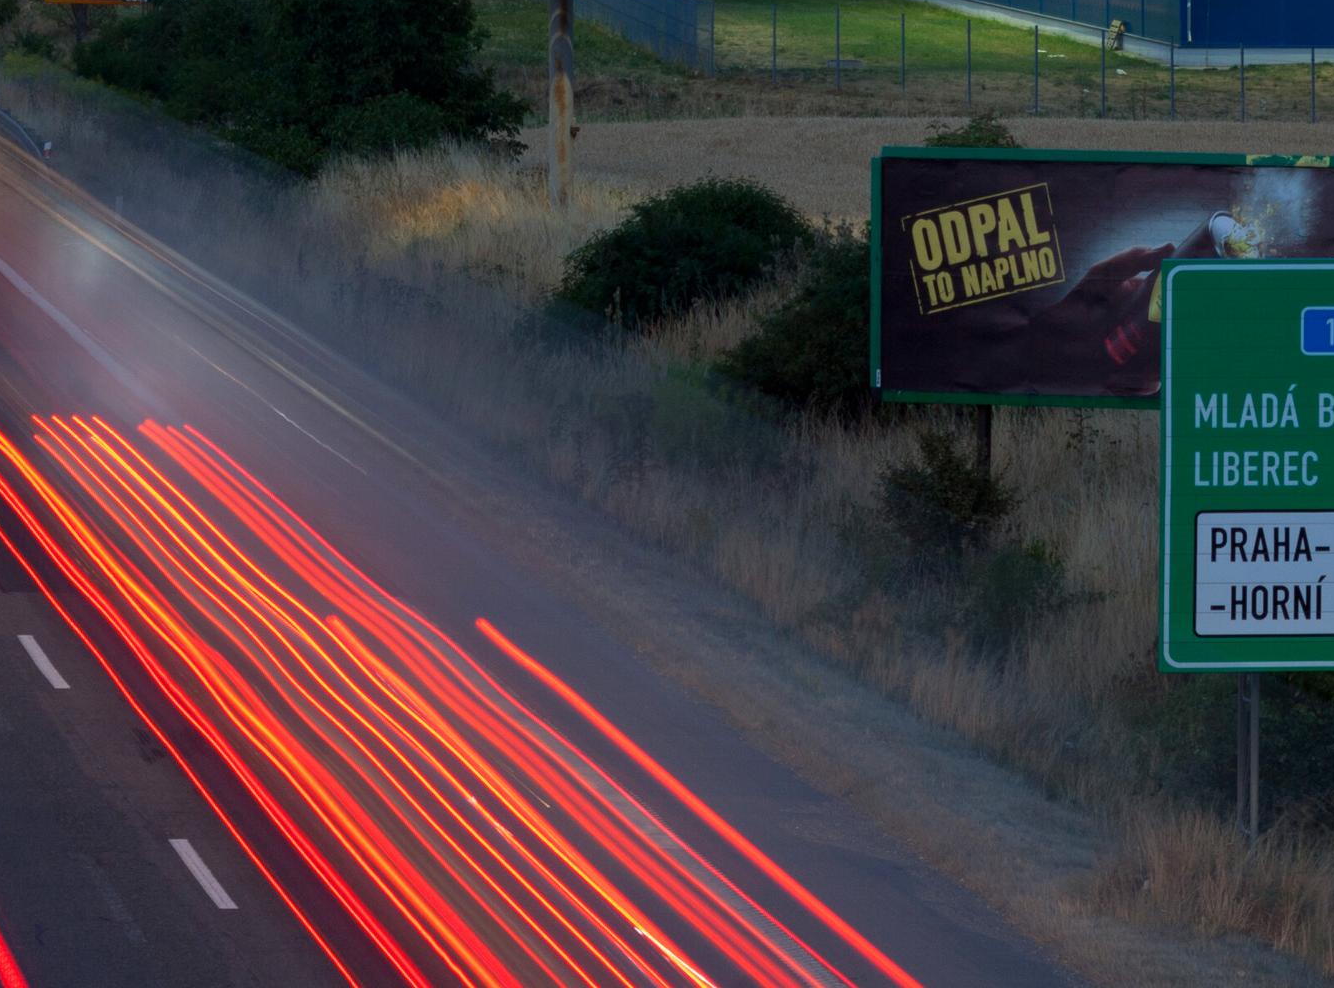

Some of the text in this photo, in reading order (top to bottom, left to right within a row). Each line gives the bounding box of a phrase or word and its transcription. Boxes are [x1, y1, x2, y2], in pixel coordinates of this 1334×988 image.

[911, 192, 1050, 271] ODPAL
[922, 246, 1057, 307] TO NAPLNO
[1194, 383, 1299, 429] MLADÁ
[1194, 451, 1319, 487] LIBEREC
[1211, 527, 1330, 563] PRAHA-
[1210, 575, 1323, 621] -HORNÍ
